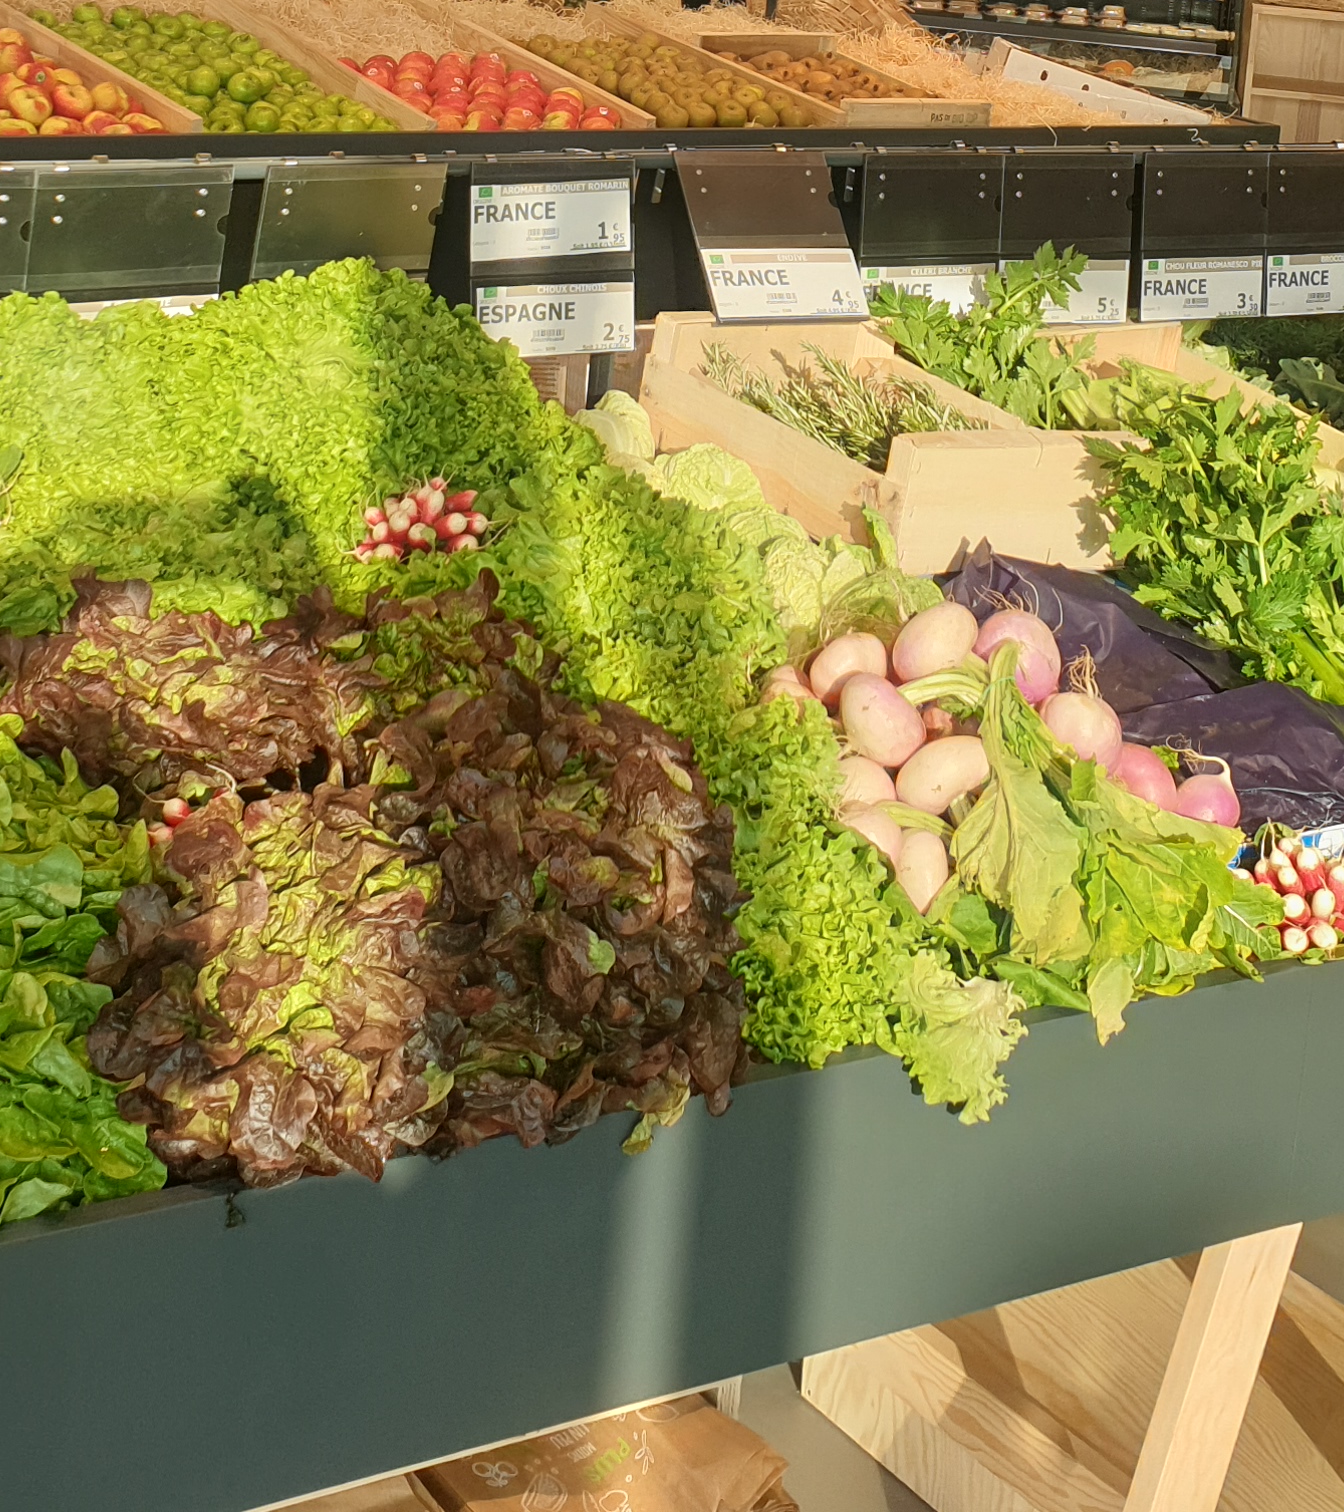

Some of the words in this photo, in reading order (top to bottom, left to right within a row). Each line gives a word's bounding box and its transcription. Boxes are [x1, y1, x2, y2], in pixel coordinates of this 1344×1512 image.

[502, 183, 544, 195] AROMATE
[545, 183, 586, 193] BOUQUET
[588, 181, 629, 191] ROMARIN
[473, 201, 556, 224] FRANCE
[598, 221, 609, 240] 1
[613, 233, 625, 243] 95
[709, 269, 790, 287] FRANCE
[1269, 269, 1329, 288] FRANCE
[536, 285, 568, 294] CHOUX
[569, 283, 607, 293] CHINOIS
[1143, 278, 1207, 297] FRANCE
[832, 289, 844, 306] 4
[1097, 297, 1107, 313] 5
[1237, 292, 1246, 309] 3
[479, 301, 576, 325] ESPAGNE
[603, 322, 615, 341] 2
[618, 334, 630, 344] 75
